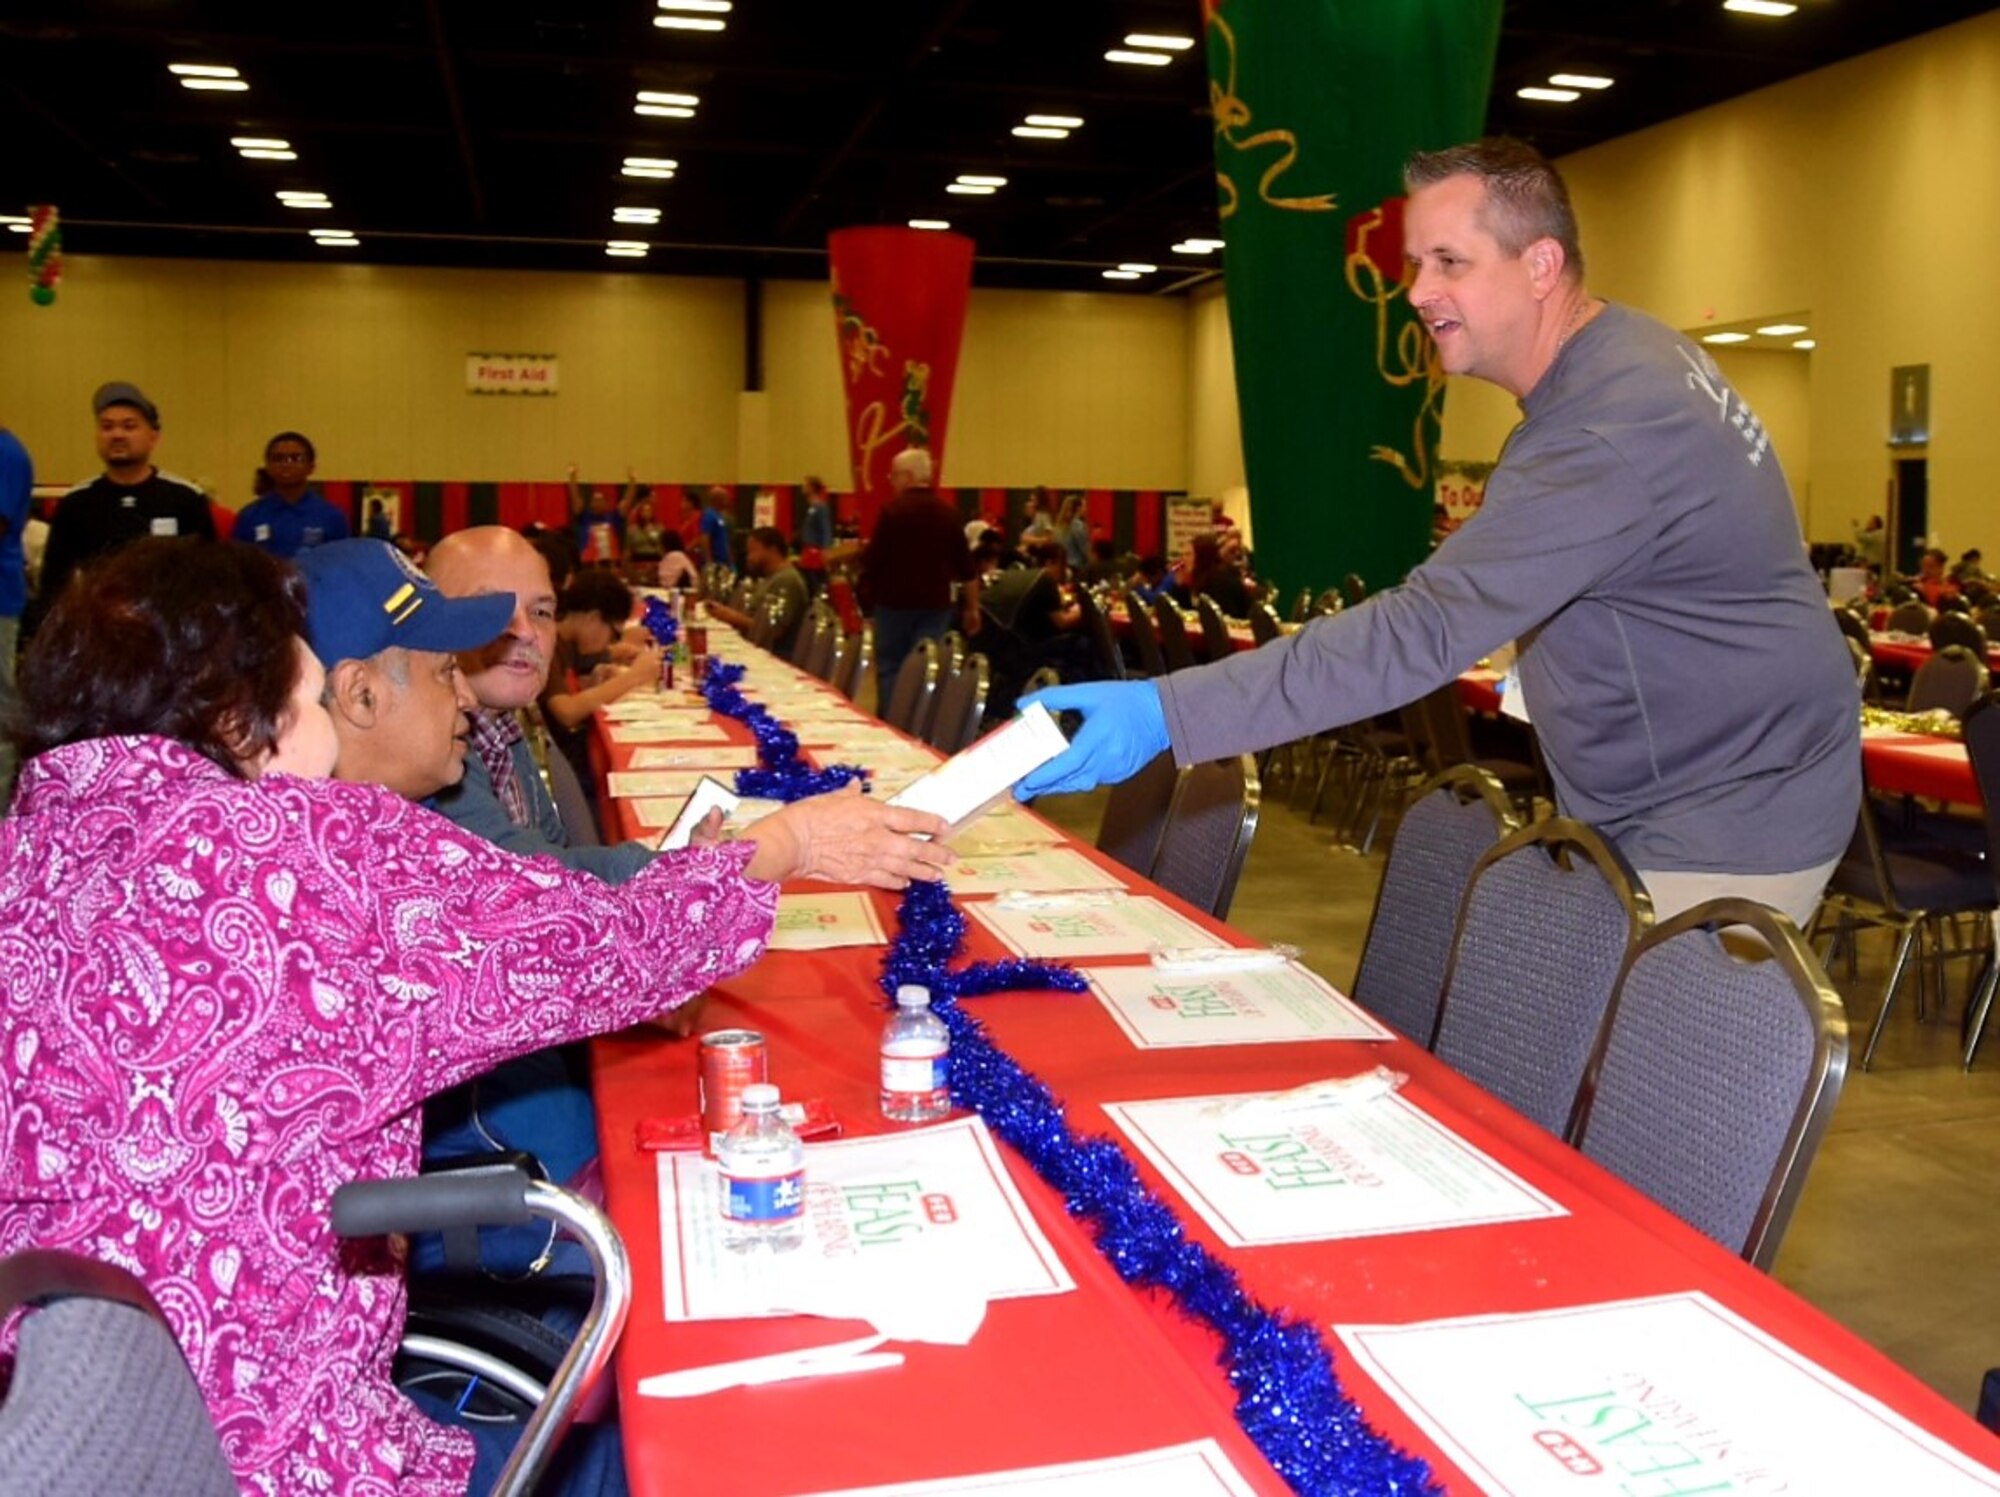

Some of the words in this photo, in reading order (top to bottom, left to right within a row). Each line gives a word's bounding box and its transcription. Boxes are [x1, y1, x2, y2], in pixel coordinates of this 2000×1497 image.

[478, 365, 515, 382] First
[519, 366, 548, 382] Aid
[1440, 484, 1458, 508] To
[1218, 1132, 1347, 1191] FEAST
